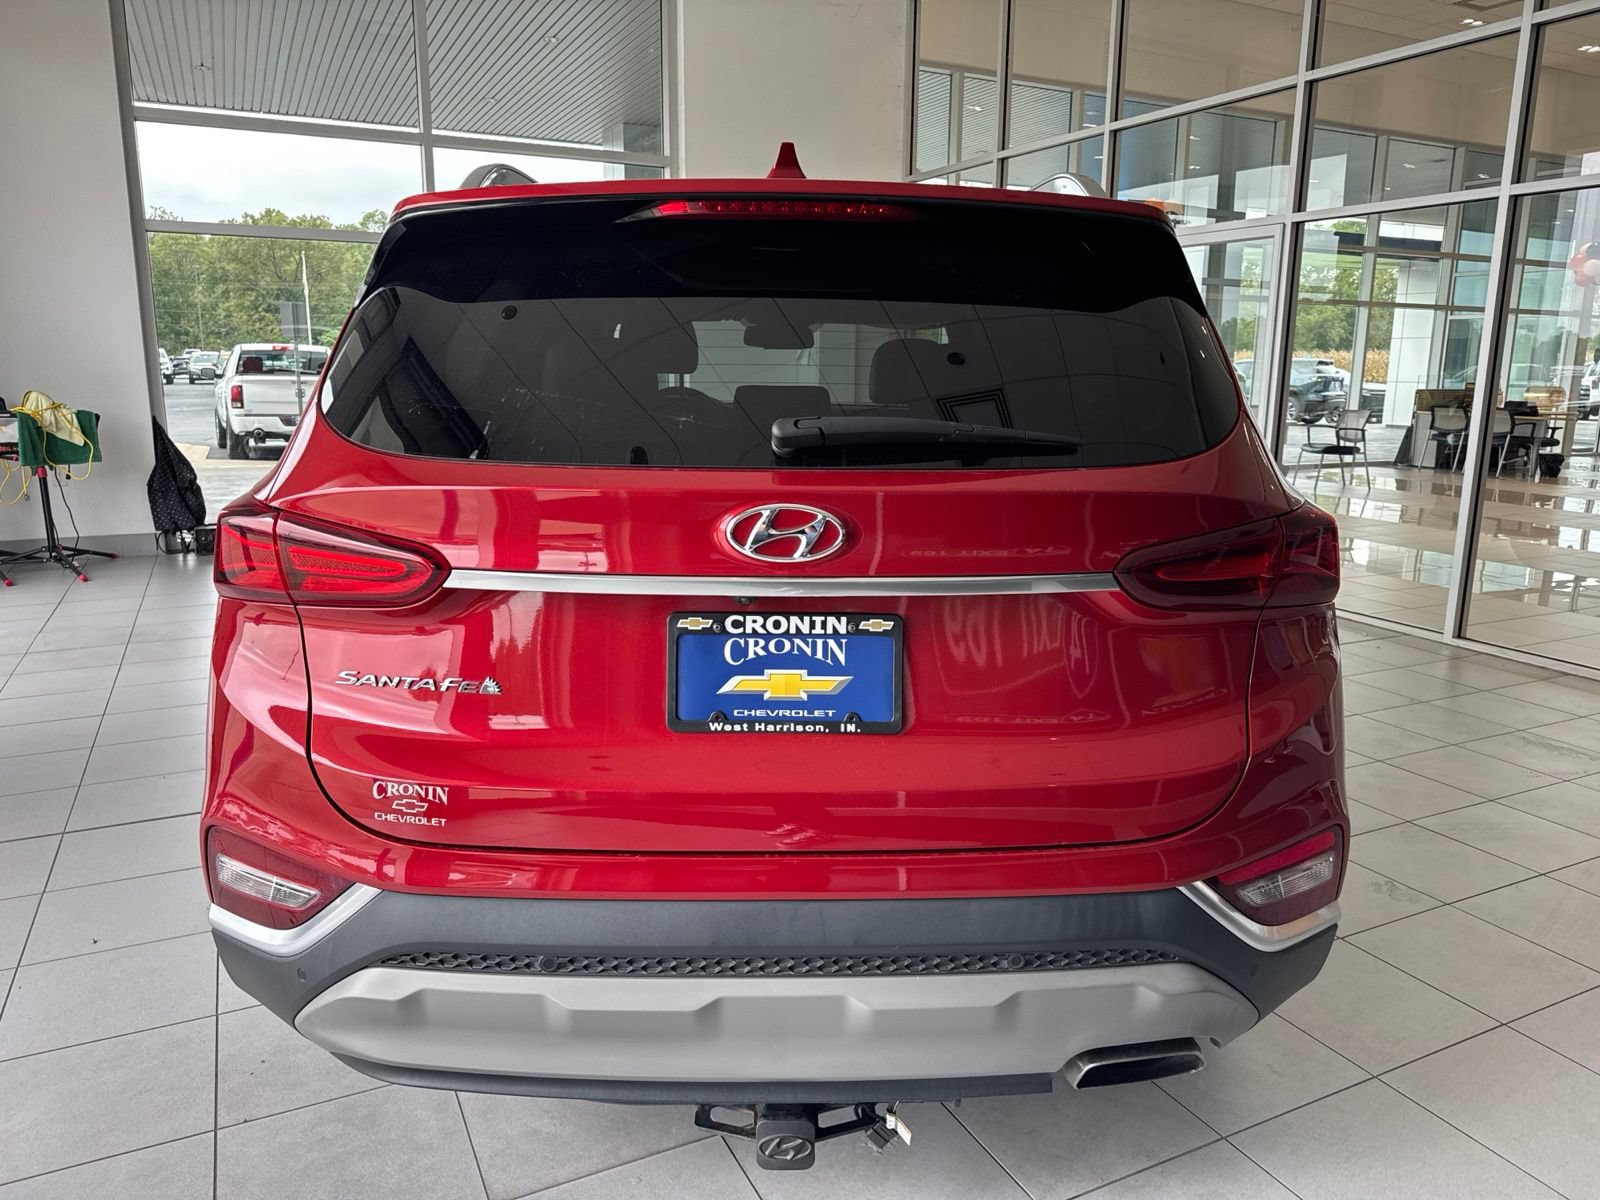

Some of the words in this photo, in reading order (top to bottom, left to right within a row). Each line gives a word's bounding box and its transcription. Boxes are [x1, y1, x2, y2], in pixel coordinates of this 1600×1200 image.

[724, 615, 848, 635] CRONIN
[723, 637, 848, 666] CRONIN
[733, 709, 836, 717] CHEVROLET
[709, 722, 748, 731] West
[755, 722, 829, 733] Harrison,
[840, 723, 861, 732] IN.
[372, 780, 449, 805] CRONIN
[374, 811, 447, 827] CHEVROLET
